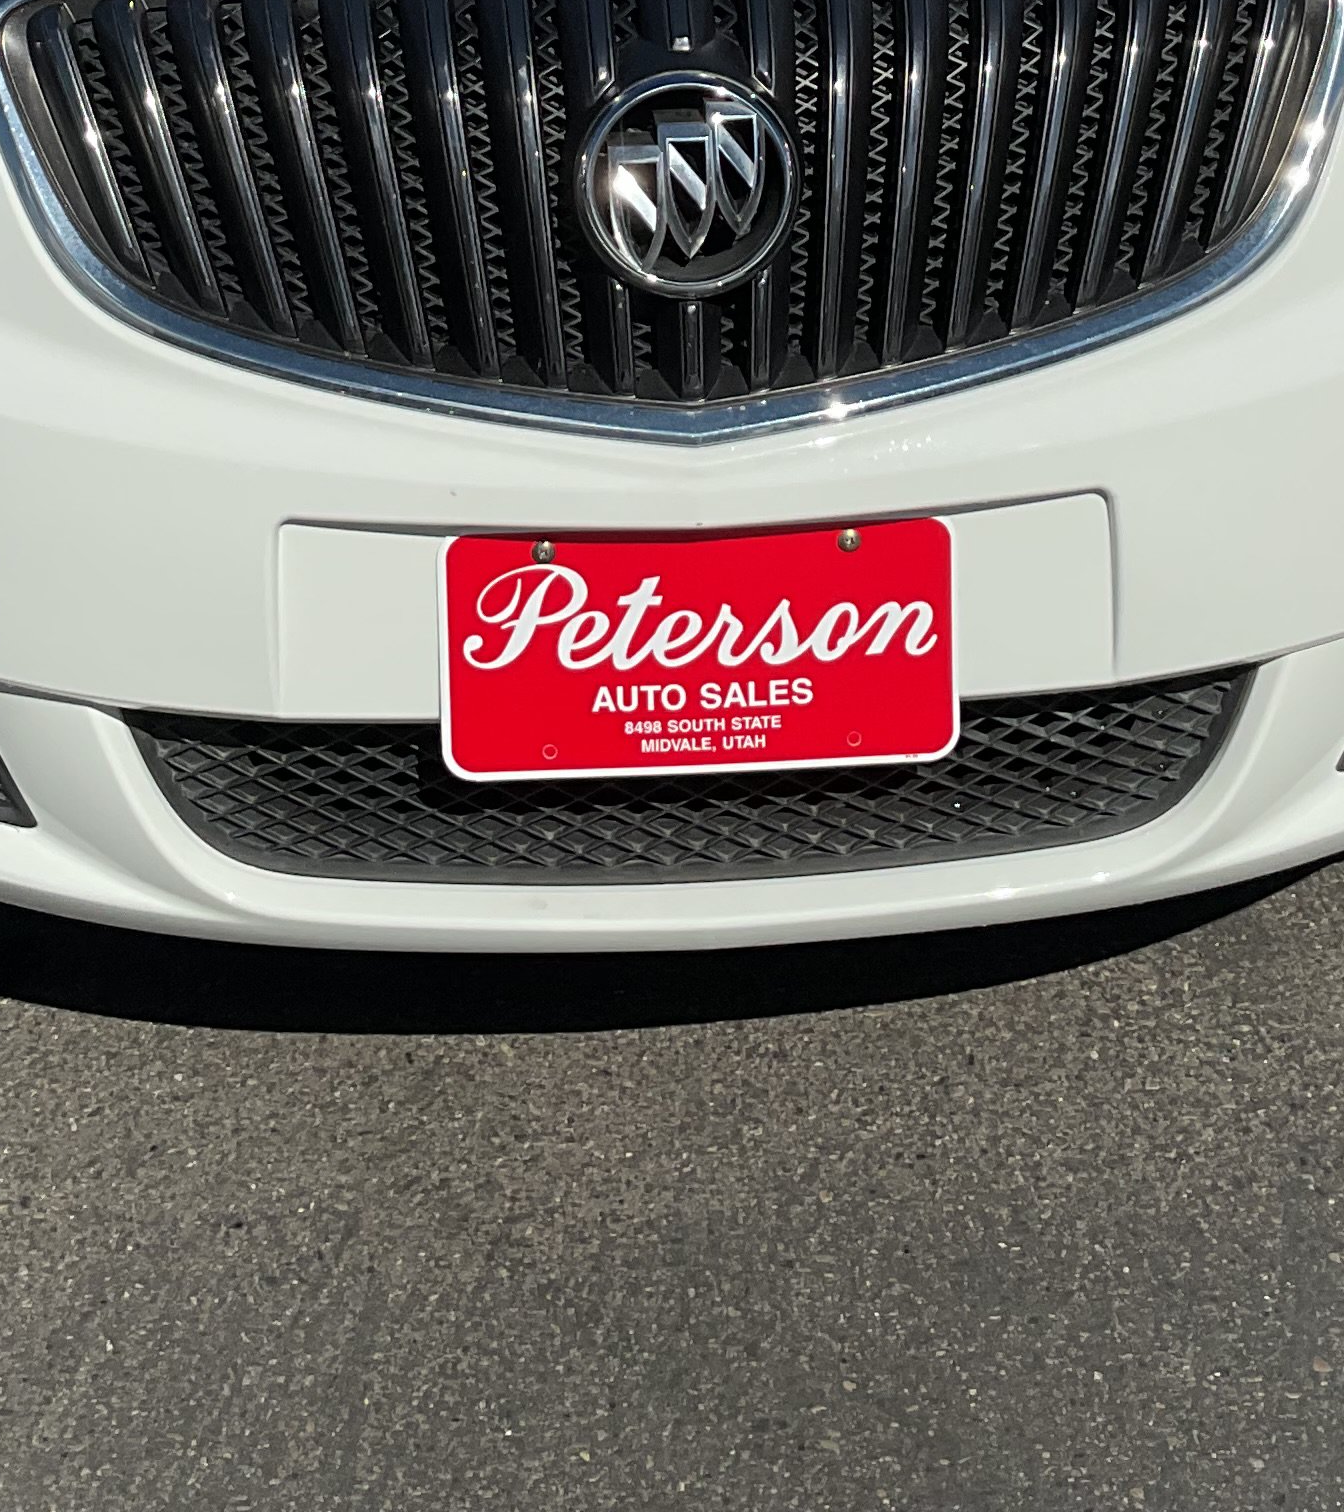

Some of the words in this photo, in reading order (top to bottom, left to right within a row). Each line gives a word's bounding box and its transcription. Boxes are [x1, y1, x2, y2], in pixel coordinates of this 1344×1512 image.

[462, 563, 938, 671] Peterson
[591, 683, 687, 713] AUTO
[699, 677, 814, 710] SALES
[624, 720, 662, 735] 8498
[667, 717, 726, 734] SOUTH
[731, 714, 782, 731] STATE
[640, 736, 717, 753] MIDVALE,
[722, 734, 766, 751] UTAH
